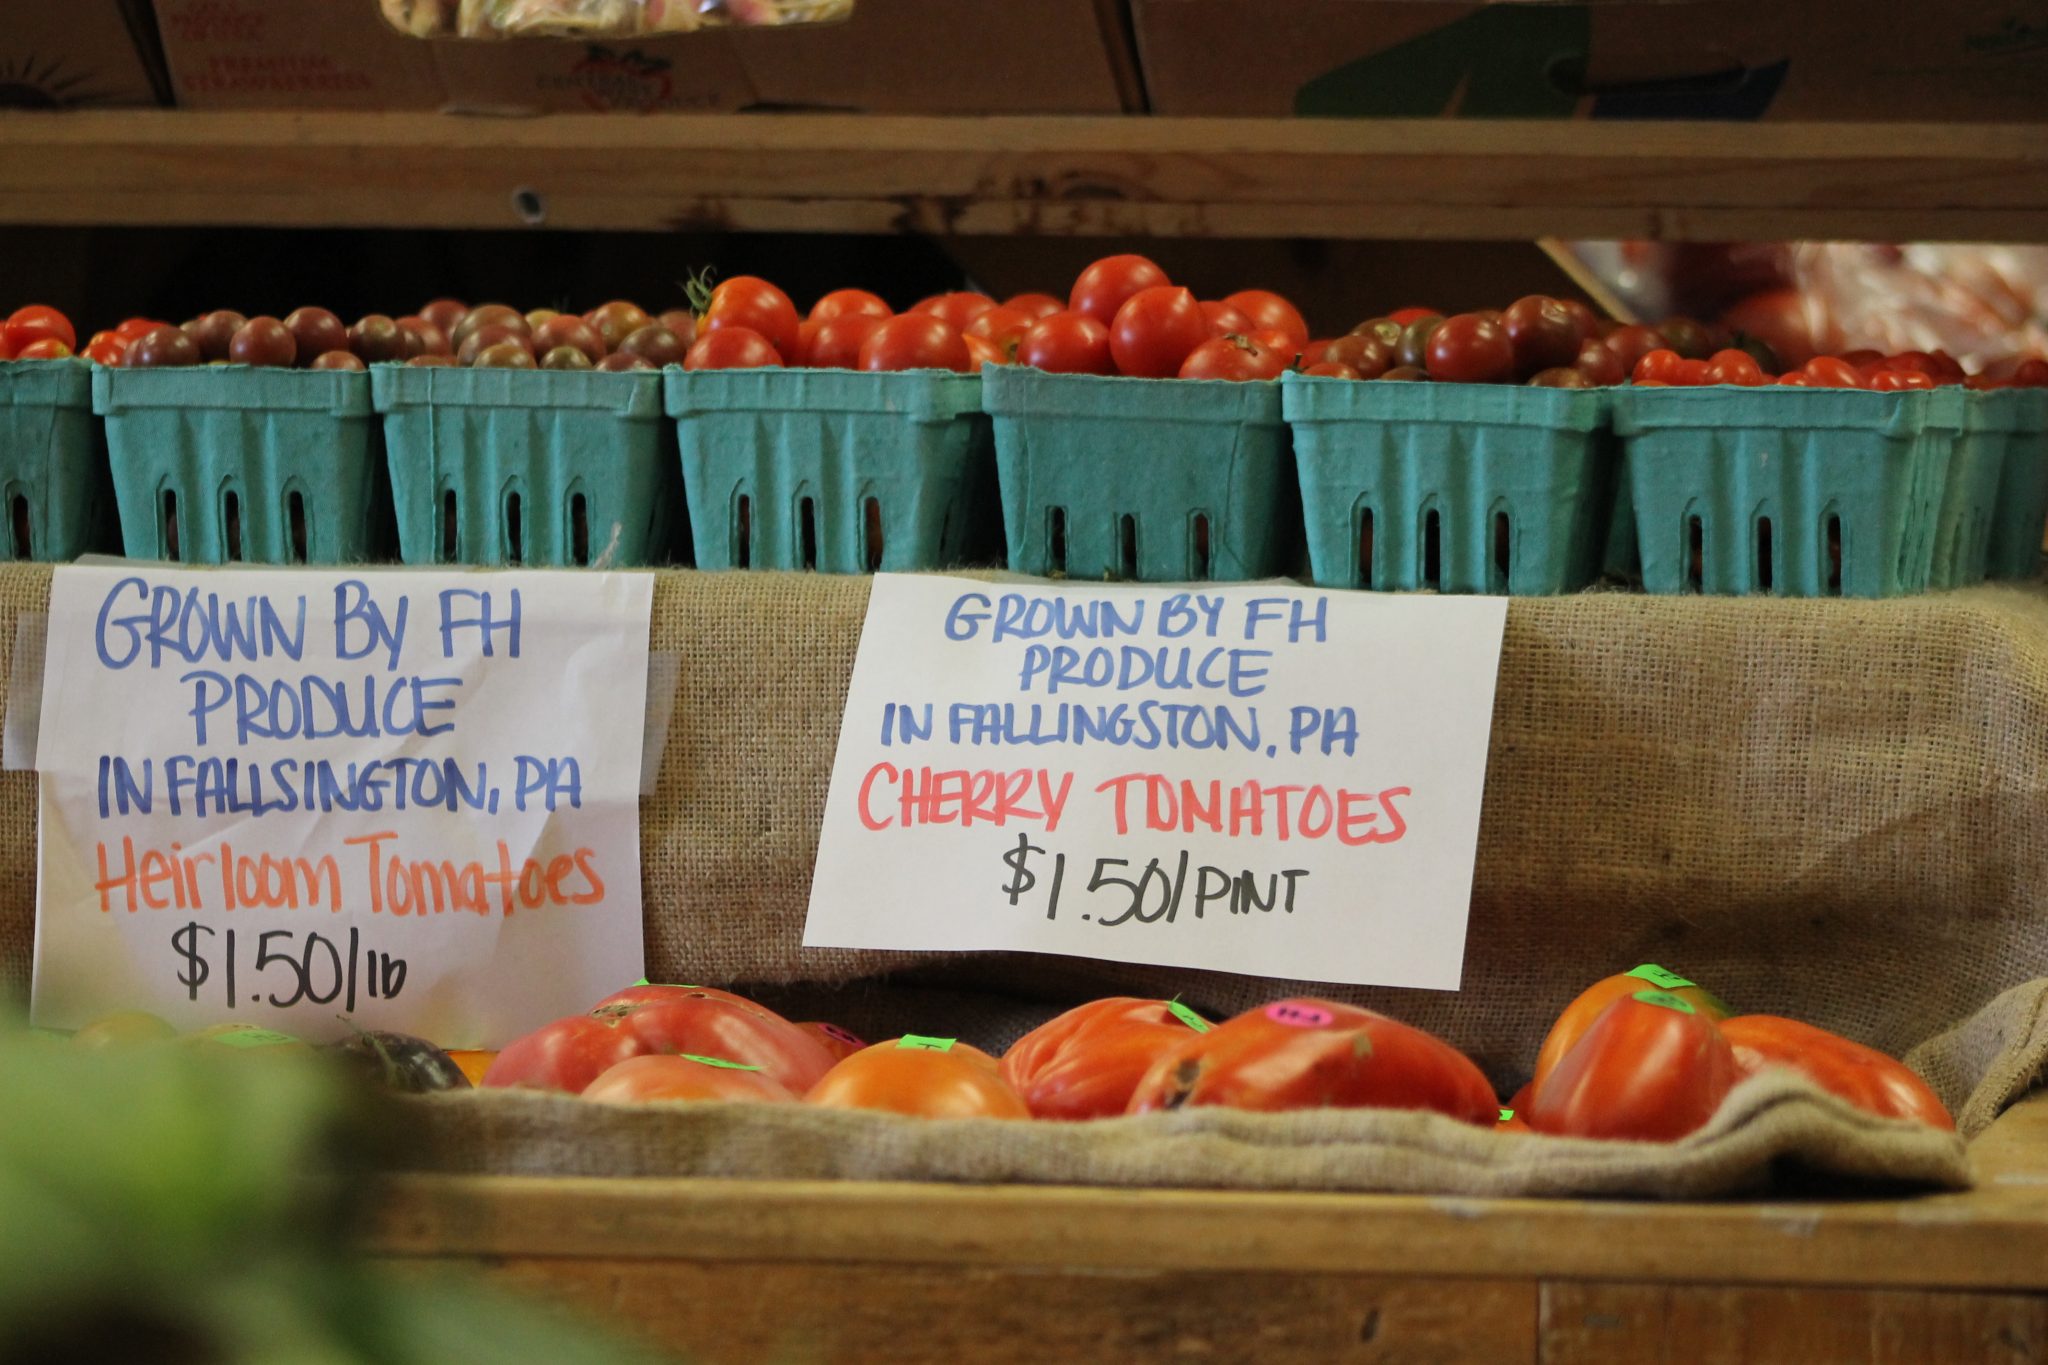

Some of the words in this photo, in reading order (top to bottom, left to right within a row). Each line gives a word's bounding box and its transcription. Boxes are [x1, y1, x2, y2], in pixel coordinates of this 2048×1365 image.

[96, 577, 307, 669] GROWN
[438, 588, 522, 659] FH
[944, 592, 1145, 642] GROWN
[1157, 593, 1225, 638] BY
[1244, 596, 1328, 643] FH
[1019, 644, 1273, 697] PRODUCE
[180, 670, 464, 746] PRODUCE
[880, 702, 933, 746] IN
[1289, 706, 1360, 756] PA
[98, 754, 153, 819] IN
[165, 755, 500, 818] FALLSINGTON,
[513, 755, 583, 812] PA
[858, 761, 1074, 832] CHERRY
[95, 835, 341, 913] Heirloom
[344, 831, 605, 916] Tomatoes
[1001, 832, 1310, 927] $1.50/PINT
[171, 921, 408, 1012] $1.50/lb
